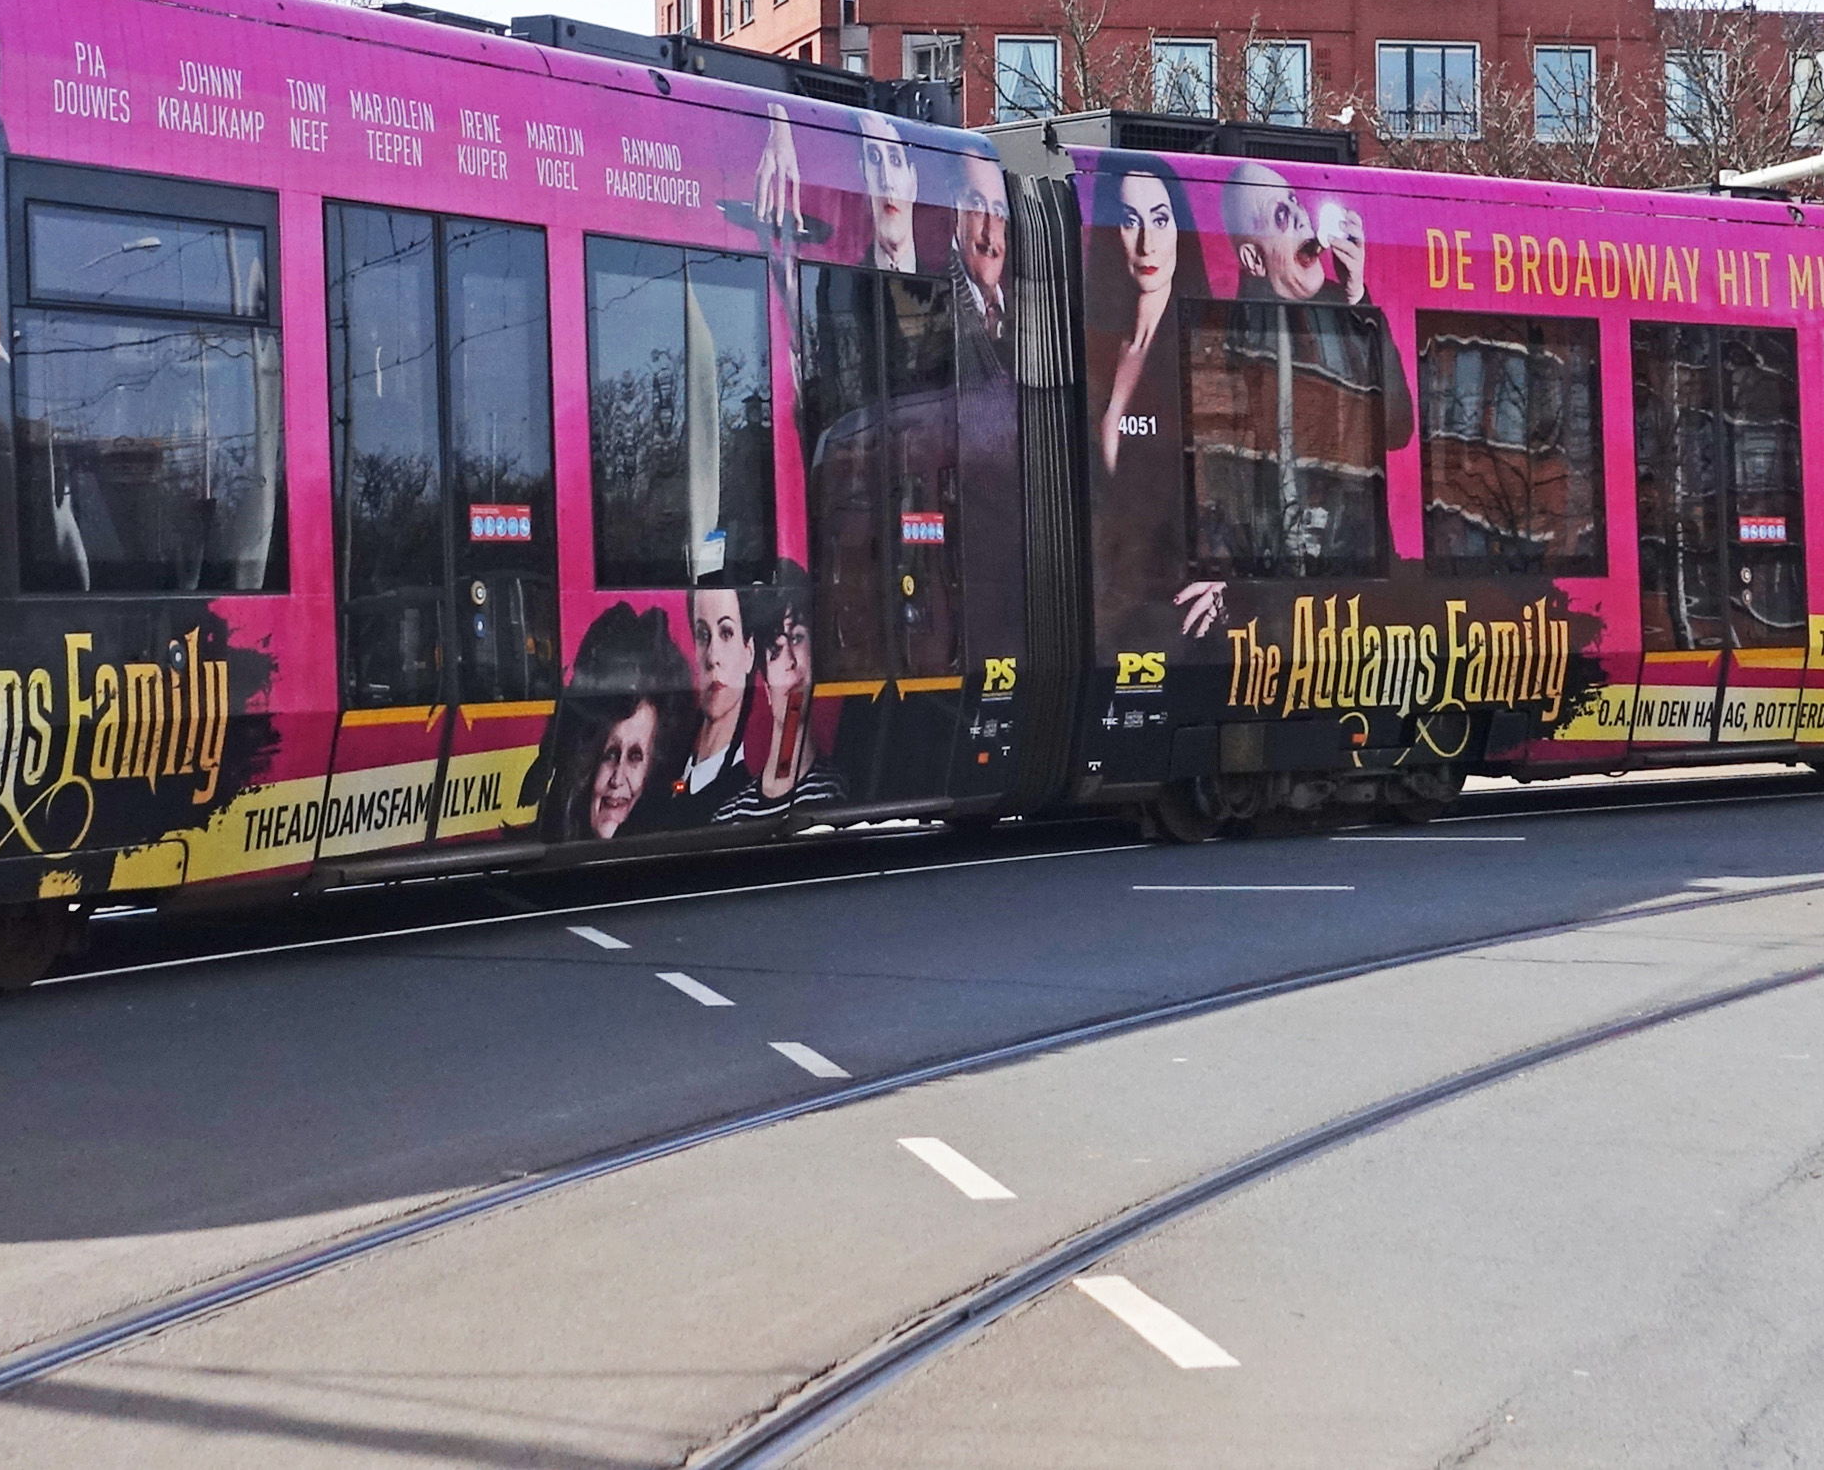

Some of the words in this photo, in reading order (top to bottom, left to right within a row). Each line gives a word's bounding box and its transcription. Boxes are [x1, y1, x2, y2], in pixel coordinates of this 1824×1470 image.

[75, 42, 106, 78] PIA
[178, 60, 242, 100] JOHNNY
[286, 79, 326, 115] TONY
[54, 79, 130, 123] DOUWES
[349, 90, 435, 132] MARJOLEIN
[158, 97, 264, 143] KRAAIJKAMP
[290, 117, 328, 152] NEEF
[460, 109, 502, 144] IRENE
[366, 130, 422, 167] TEEPEN
[526, 120, 584, 157] MARTIJN
[621, 137, 681, 172] RAYMOND
[457, 144, 508, 180] KUIPER
[536, 157, 578, 191] VOGEL
[606, 168, 701, 208] PAARDEKOOPER
[1426, 228, 1474, 290] DE
[1492, 233, 1700, 304] BROADWAY
[1717, 249, 1770, 307] HIT
[1118, 415, 1157, 435] 4051
[983, 657, 1017, 691] PS
[1117, 651, 1166, 684] PS
[1227, 617, 1281, 715] The
[1281, 593, 1438, 720] Addams
[1438, 595, 1569, 723] Family
[59, 625, 228, 806] Family
[1598, 699, 1632, 727] O.A.
[1636, 700, 1655, 727] IN
[1657, 700, 1691, 727] DEN
[1692, 700, 1748, 732] HAAG,
[244, 772, 502, 852] THEADDAMSFAMILY.NL
